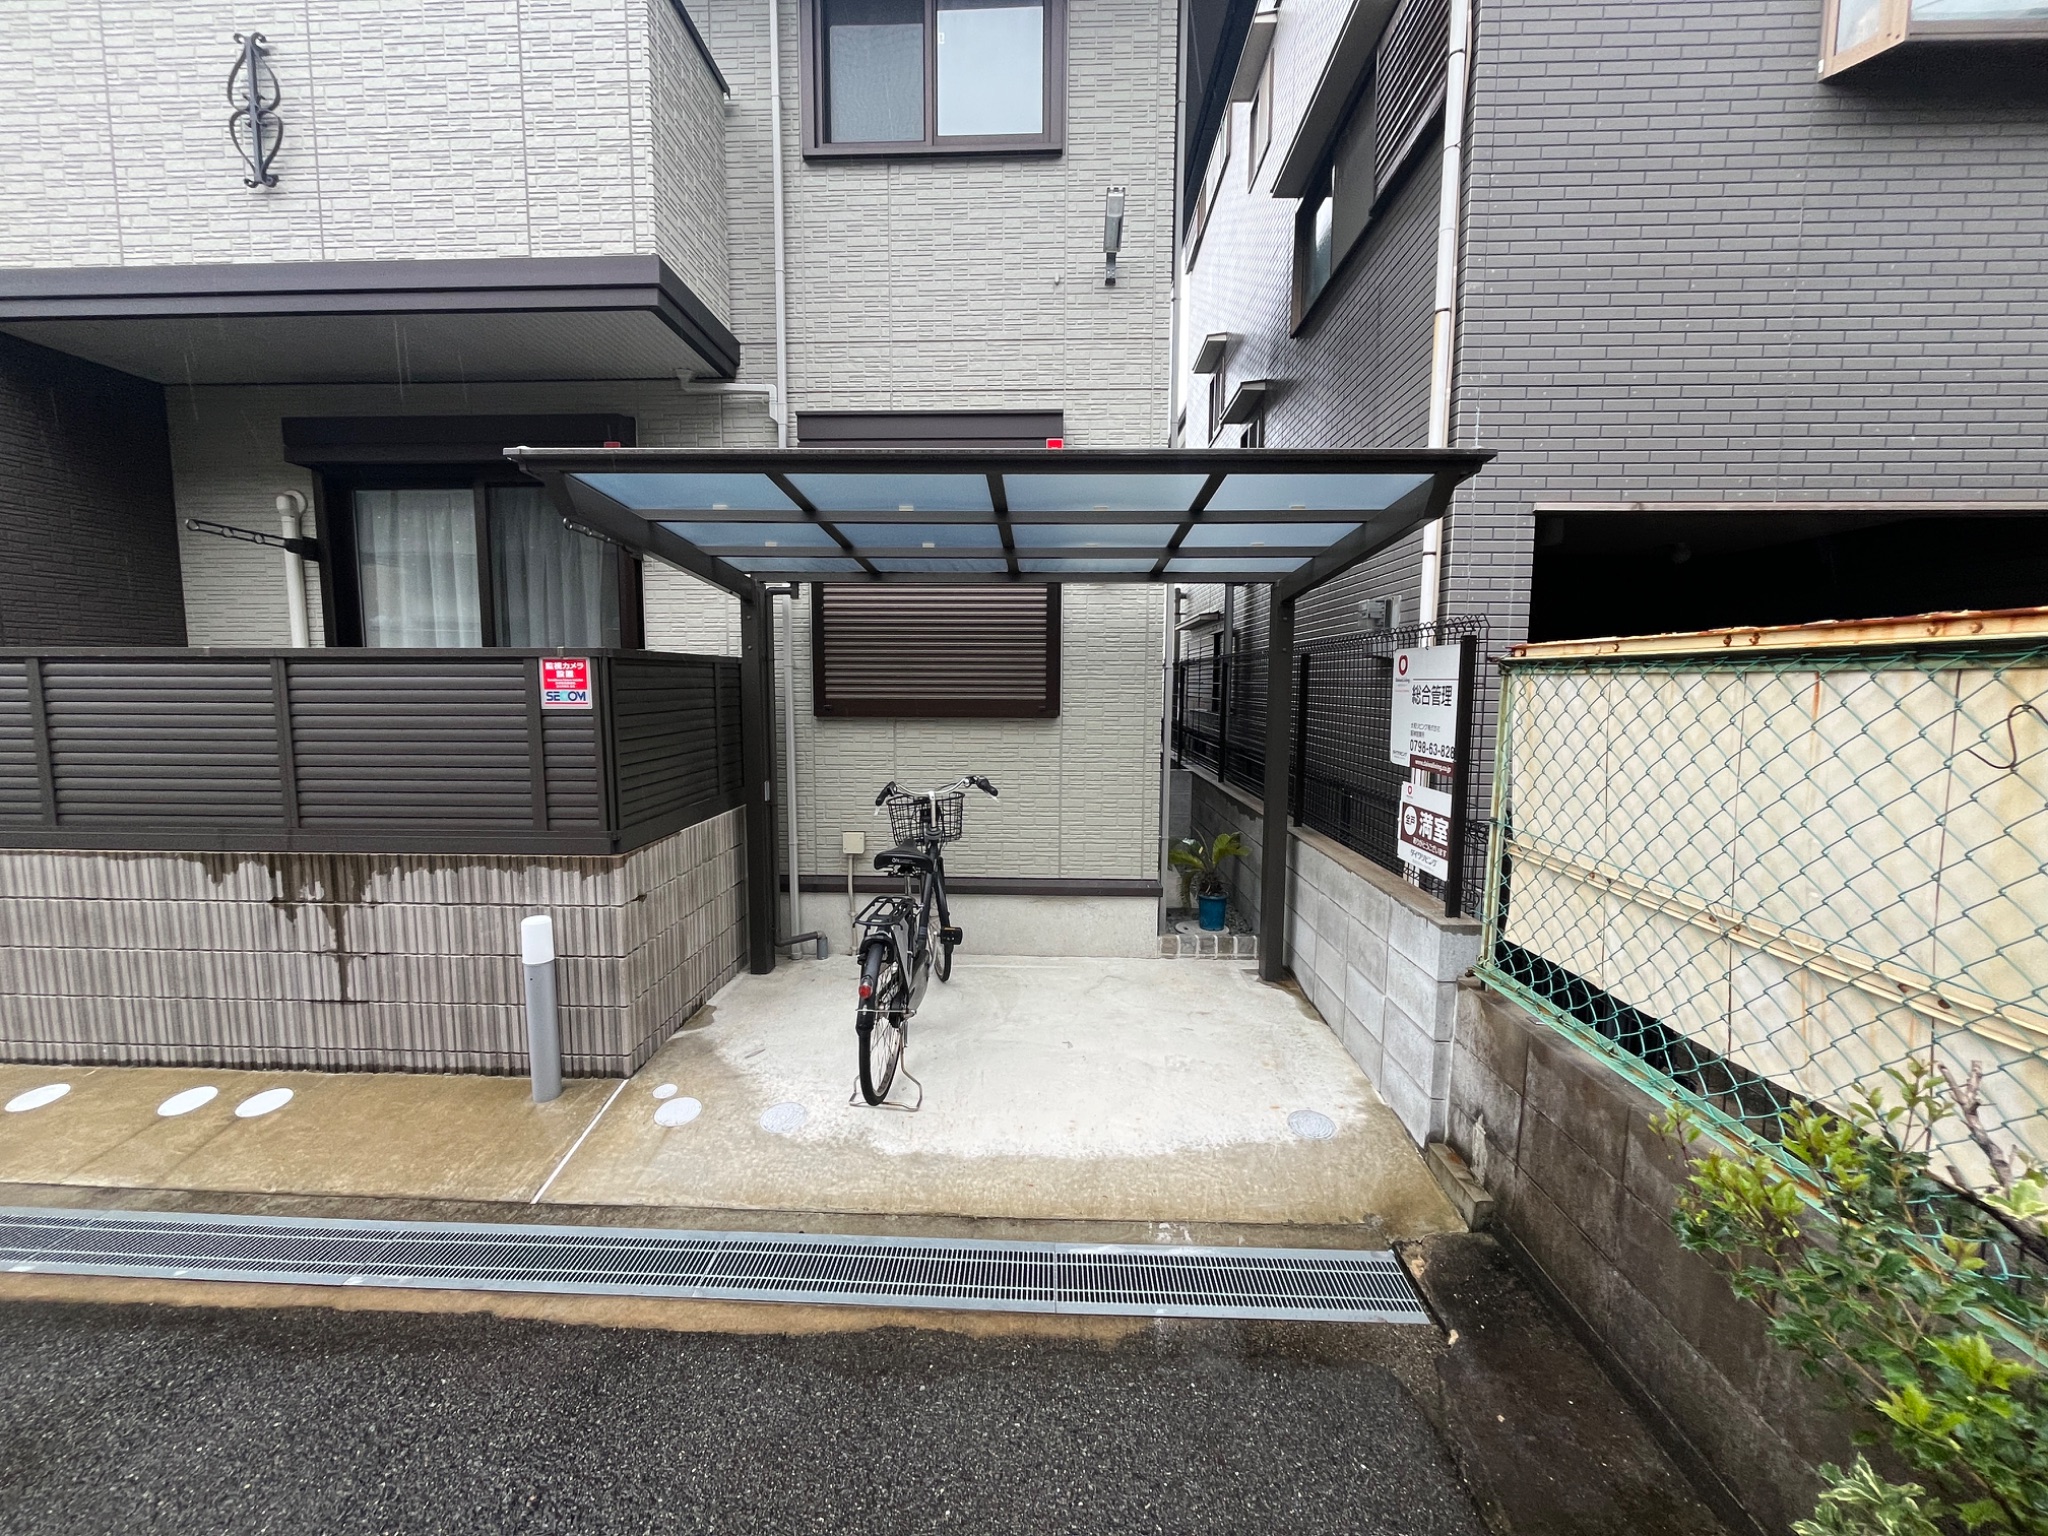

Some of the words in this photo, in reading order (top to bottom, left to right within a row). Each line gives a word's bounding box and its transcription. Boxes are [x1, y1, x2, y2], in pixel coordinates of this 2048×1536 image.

[546, 691, 586, 701] SECOM
[1412, 684, 1452, 707] 総合管理
[1419, 811, 1449, 846] 満室
